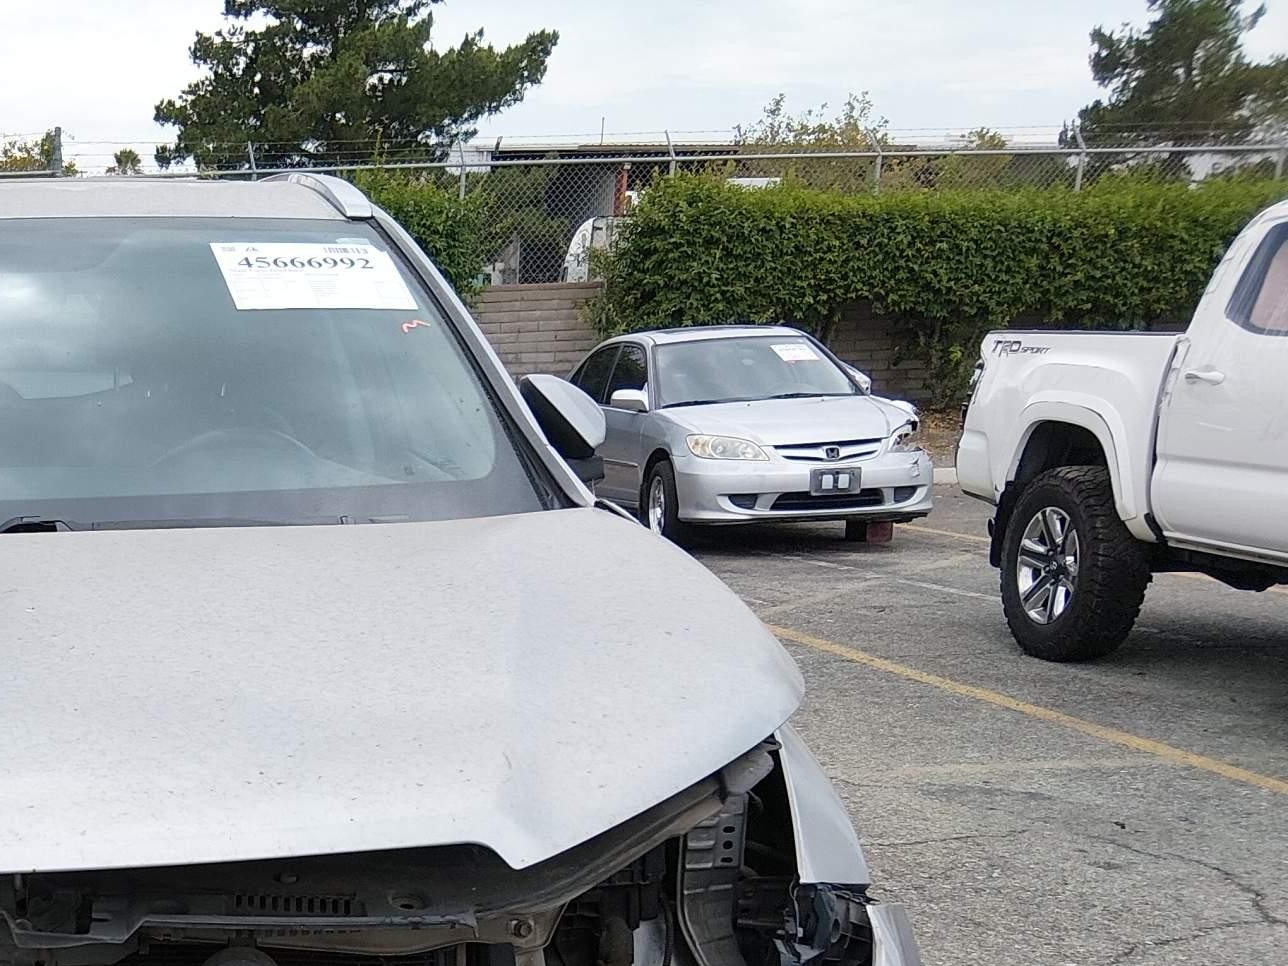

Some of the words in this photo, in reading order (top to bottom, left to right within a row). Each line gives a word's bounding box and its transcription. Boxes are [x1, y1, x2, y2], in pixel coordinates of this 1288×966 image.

[237, 255, 374, 270] 45666992
[992, 340, 1022, 357] TRD
[1021, 346, 1051, 354] SPORT
